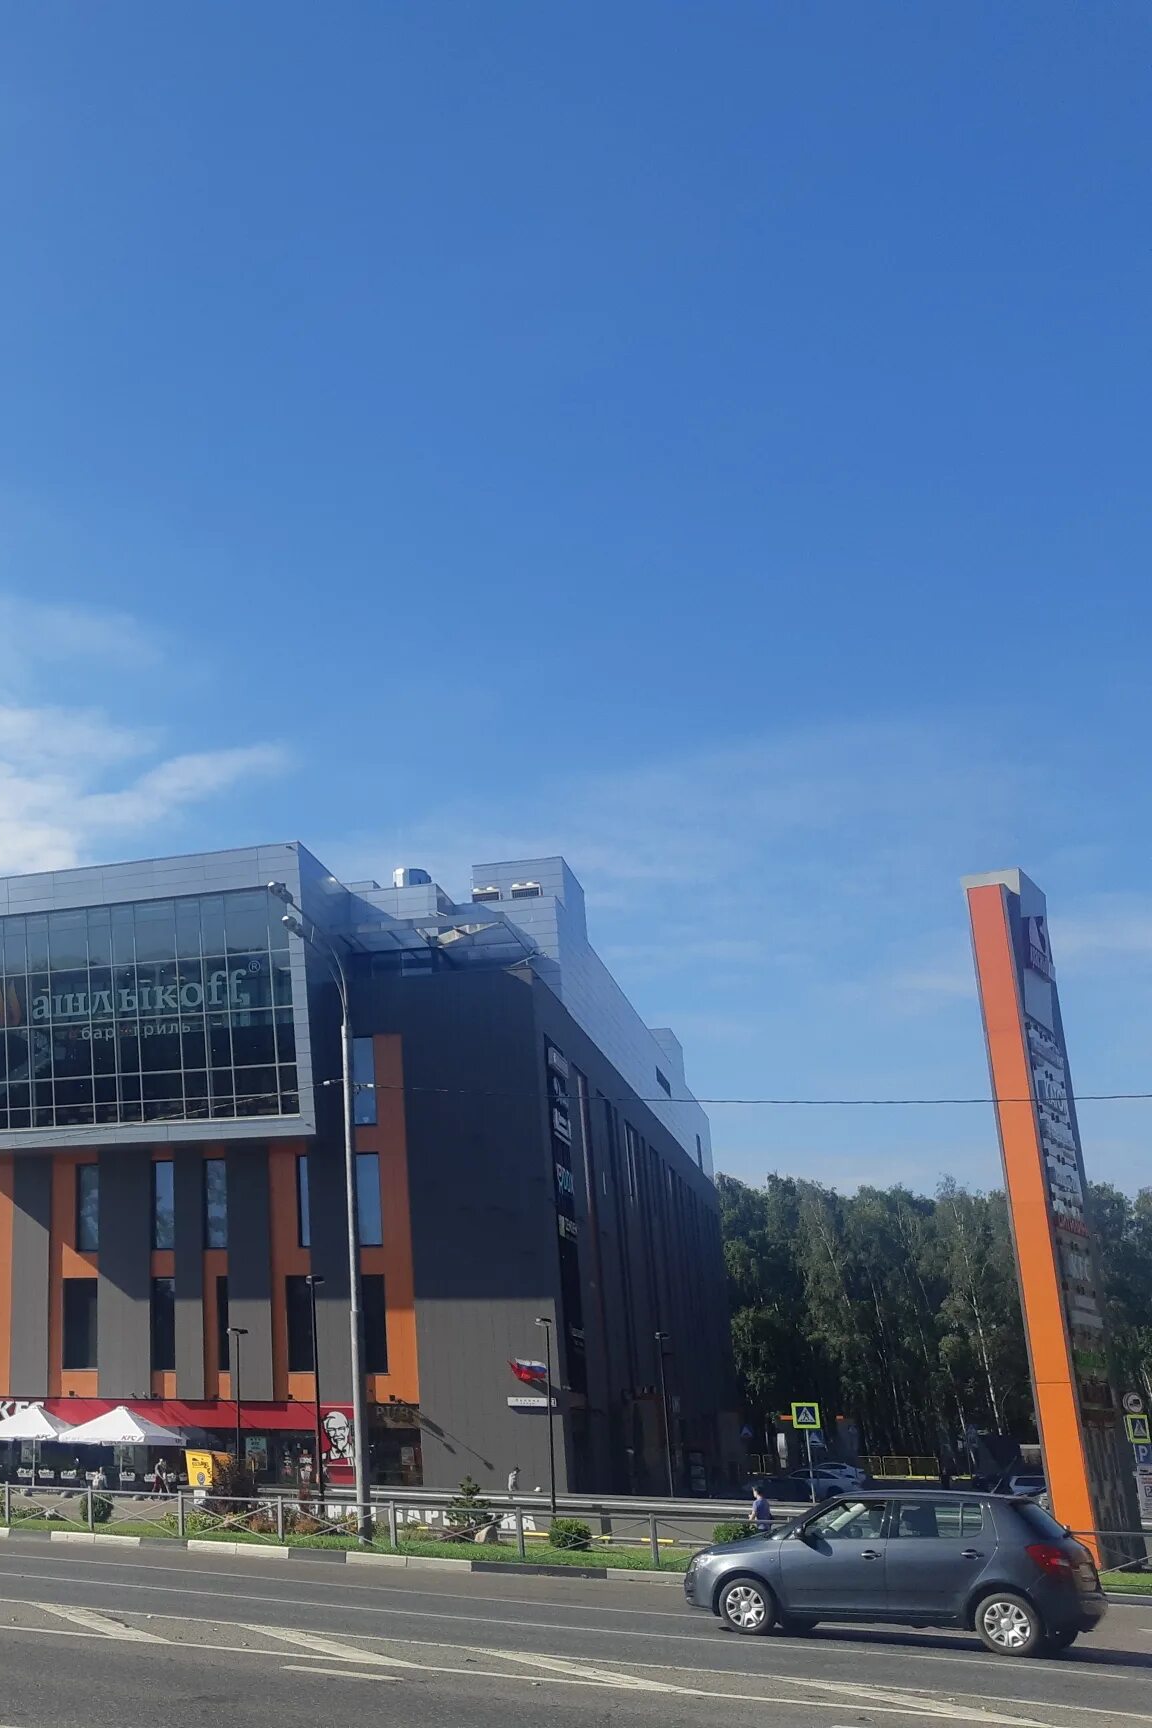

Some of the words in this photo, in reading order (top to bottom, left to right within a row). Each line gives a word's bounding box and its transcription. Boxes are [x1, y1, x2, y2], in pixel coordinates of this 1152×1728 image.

[81, 1026, 115, 1041] бар
[131, 1022, 191, 1038] гриль
[1138, 1445, 1148, 1462] P
